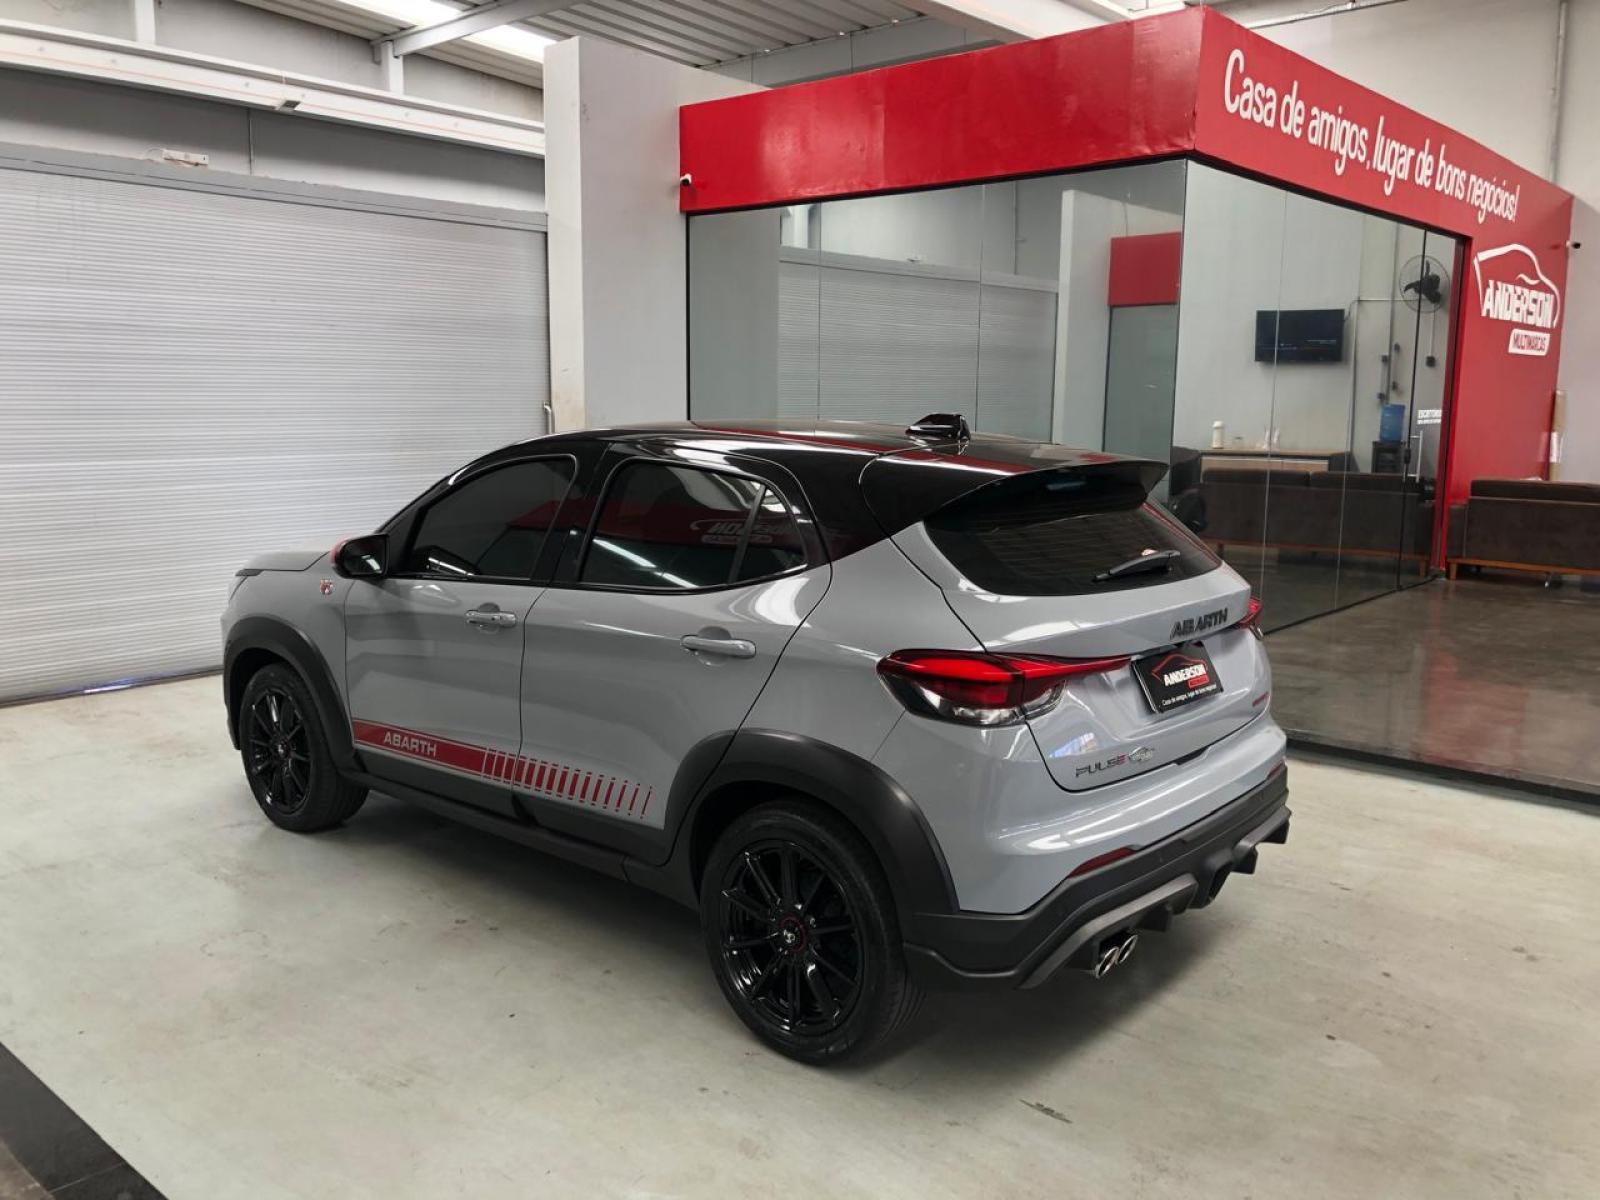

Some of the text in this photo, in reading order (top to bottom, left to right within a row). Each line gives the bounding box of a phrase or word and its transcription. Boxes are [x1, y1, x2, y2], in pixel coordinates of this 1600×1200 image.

[1224, 48, 1520, 224] Casa de amigos, lugar de bons negócios!
[1481, 279, 1554, 329] ANDERSON
[1170, 607, 1228, 640] ABARTH
[1163, 664, 1207, 686] ANDERSON
[384, 731, 437, 758] ABARTH
[1075, 754, 1126, 777] PULSE
